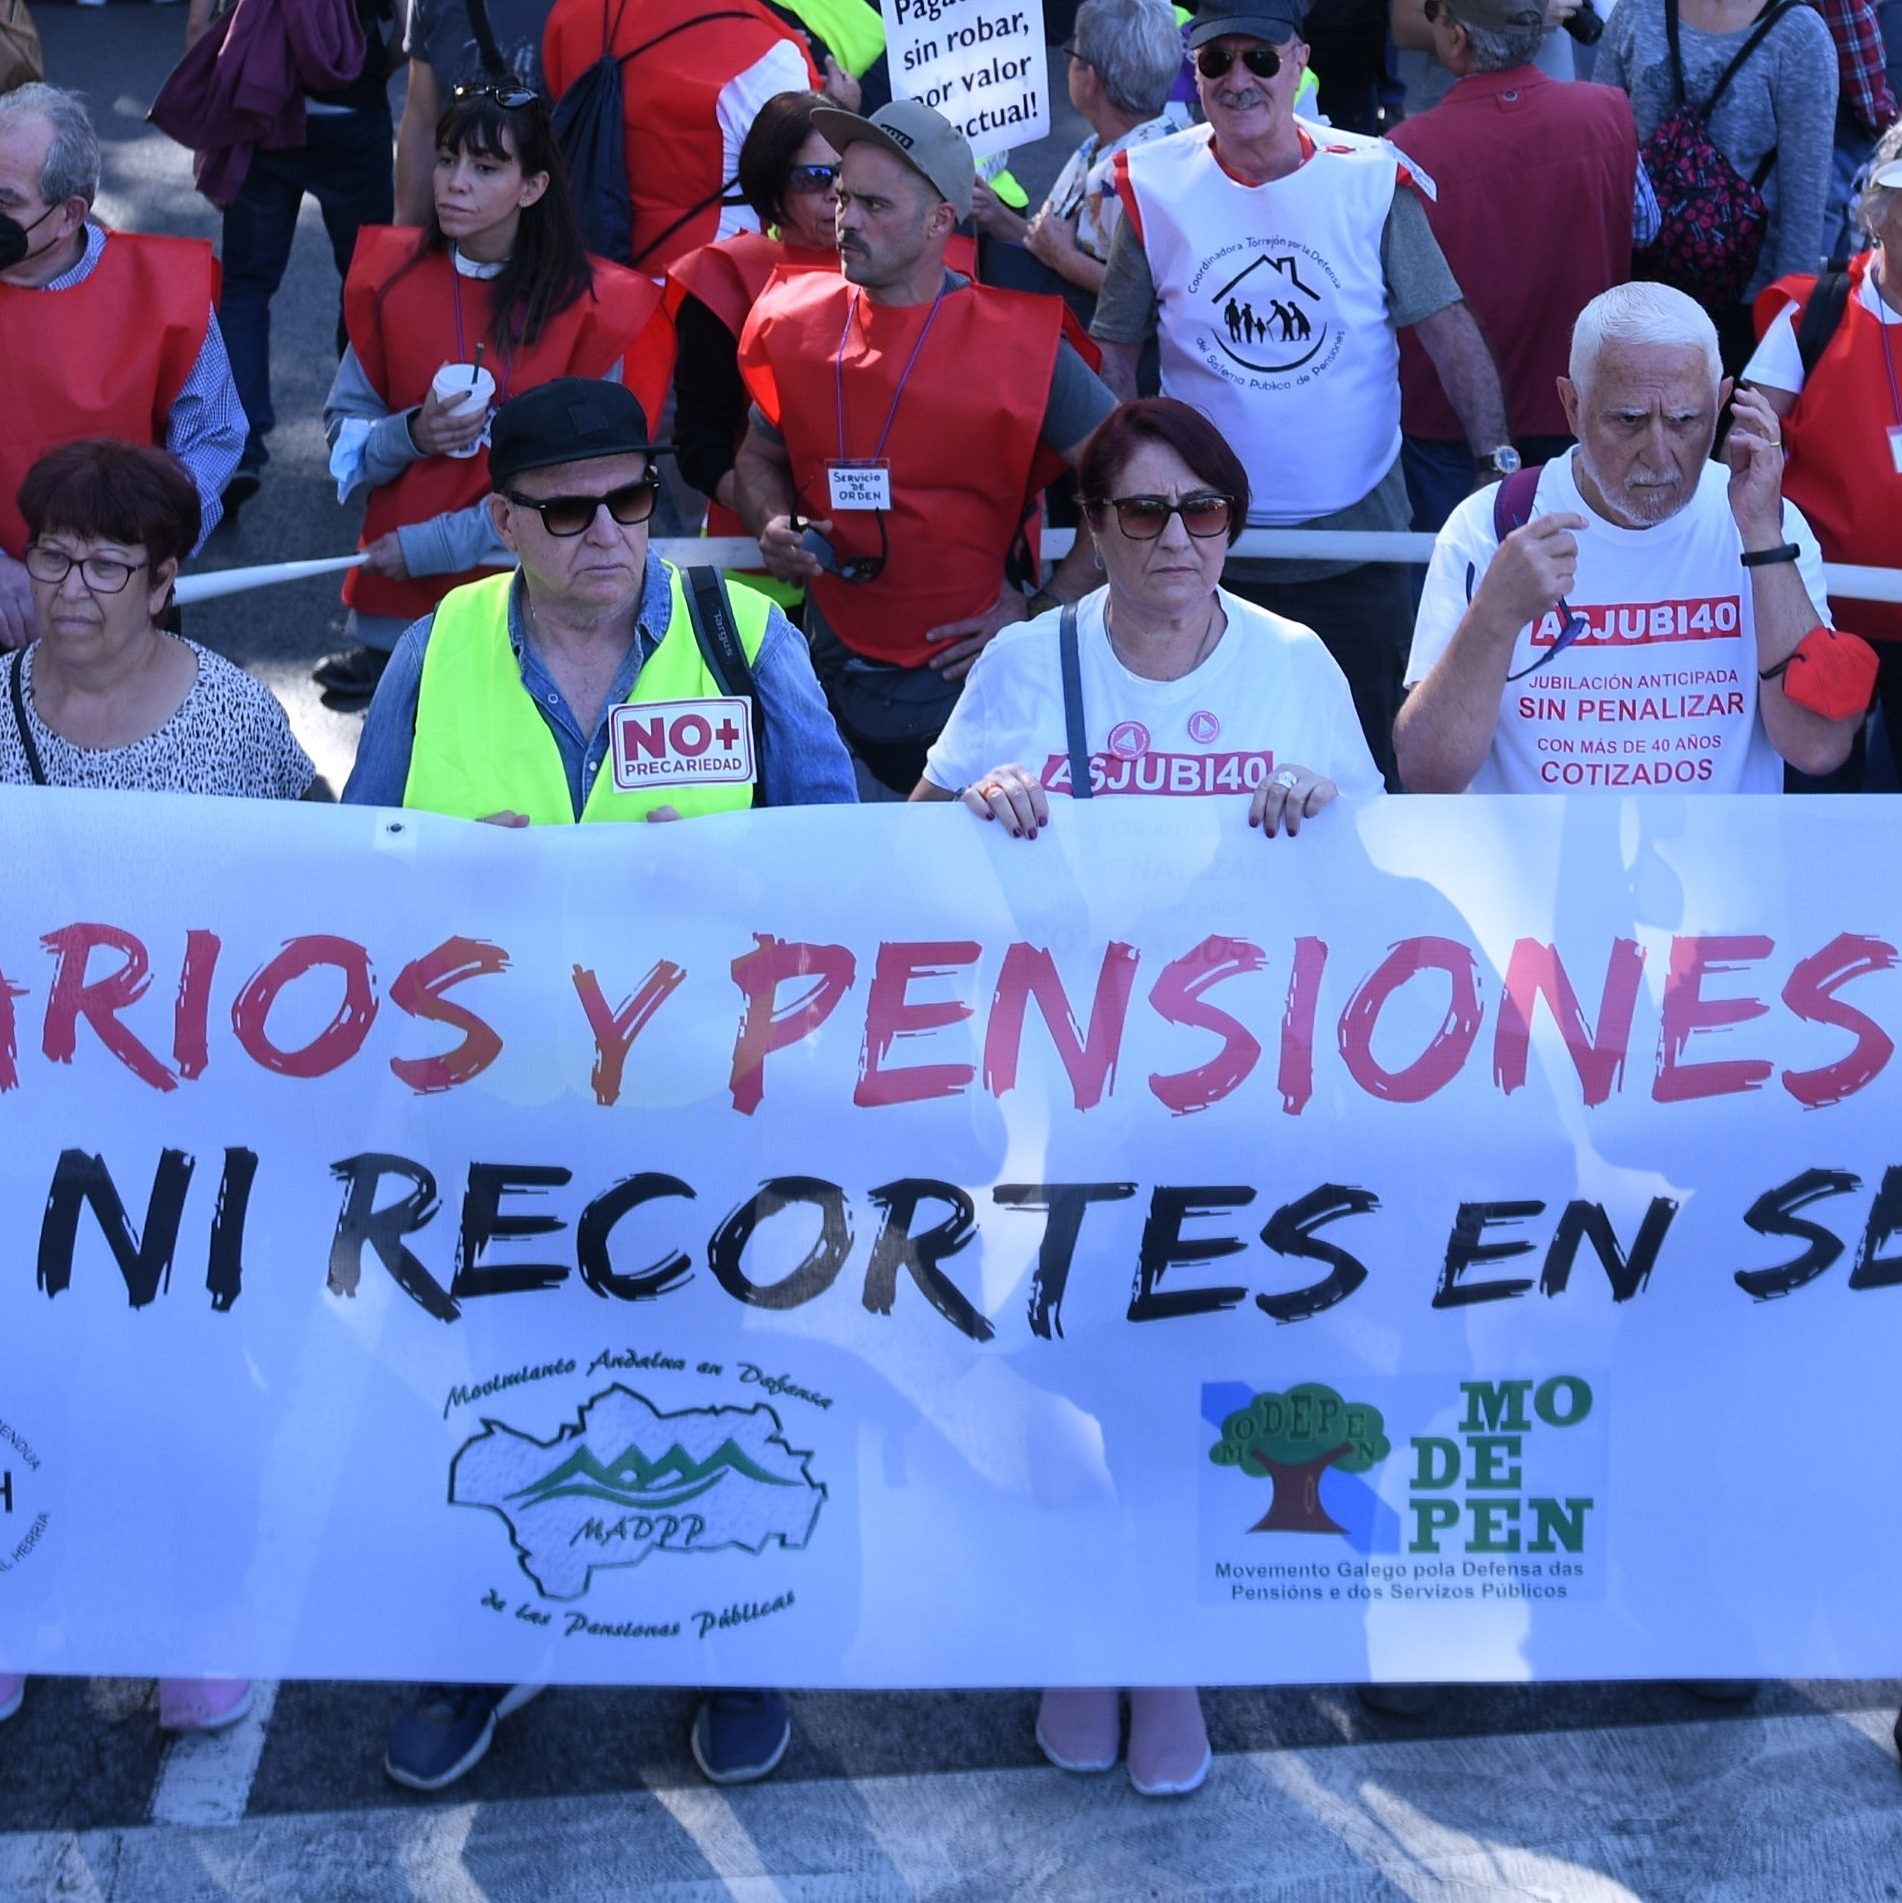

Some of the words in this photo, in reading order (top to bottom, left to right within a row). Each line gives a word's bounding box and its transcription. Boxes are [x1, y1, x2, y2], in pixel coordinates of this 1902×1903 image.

[904, 39, 938, 70] sin
[947, 12, 1029, 52] robar,
[961, 55, 1032, 92] valor
[1188, 243, 1243, 294] Coordinadora
[1246, 235, 1286, 249] Torrejón
[1309, 250, 1341, 289] Defensa
[1296, 375, 1310, 386] de
[1311, 330, 1345, 376] Pensiones
[839, 491, 881, 500] ORDEN
[712, 608, 733, 657] Targus
[1535, 602, 1737, 640] ASJUBI40
[1529, 674, 1633, 690] JUBILACIÓN
[1637, 669, 1739, 689] ANTICIPADA
[1519, 697, 1566, 721] SIN
[1577, 692, 1745, 722] PENALIZAR
[622, 713, 740, 762] NO+
[1537, 738, 1575, 753] CON
[1581, 737, 1617, 754] MÁS
[1623, 739, 1646, 753] DE
[1652, 738, 1670, 753] 40
[1675, 734, 1722, 750] AÑOS
[624, 757, 743, 777] PRECARIEDAD
[1045, 752, 1269, 797] ASJUBI40
[1541, 759, 1713, 786] COTIZADOS
[573, 960, 687, 1108] Y
[730, 931, 1897, 1117] PENSIONES
[37, 1144, 261, 1313] NI
[325, 1150, 1389, 1343] RECORTES
[1432, 1194, 1692, 1307] EN
[1458, 1375, 1593, 1433] MO
[1409, 1435, 1522, 1491] DE
[1408, 1498, 1594, 1554] PEN
[1215, 1561, 1331, 1578] Movemento
[1337, 1561, 1407, 1582] Galego
[1413, 1561, 1456, 1581] pola
[1462, 1560, 1542, 1578] Defensa
[1548, 1560, 1584, 1578] das
[1231, 1583, 1324, 1600] Pensións
[1329, 1586, 1341, 1600] e
[1347, 1583, 1383, 1600] dos
[1390, 1583, 1475, 1599] Servizos
[1481, 1582, 1568, 1599] Públicos
